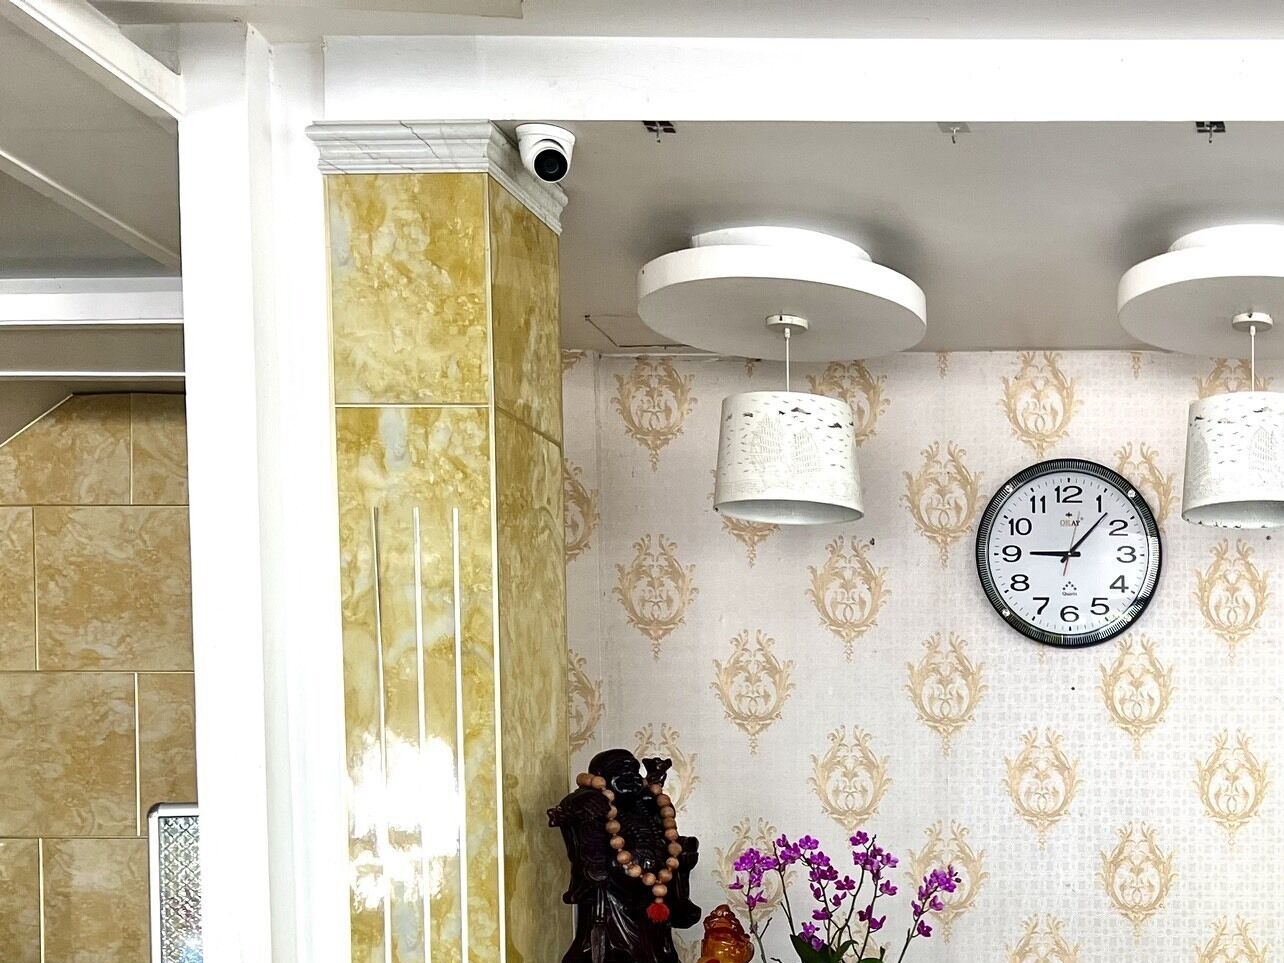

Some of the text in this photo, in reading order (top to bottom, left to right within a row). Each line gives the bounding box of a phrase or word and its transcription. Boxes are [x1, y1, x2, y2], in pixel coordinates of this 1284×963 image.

[1055, 485, 1083, 503] 12
[1030, 495, 1046, 514] 11
[1096, 495, 1102, 513] 1
[1008, 518, 1032, 536] 10
[1108, 519, 1129, 537] 2
[1002, 545, 1022, 563] 9
[1117, 545, 1137, 564] 3
[1010, 574, 1030, 592] 8
[1109, 575, 1129, 593] 4
[1032, 597, 1050, 615] 7
[1060, 605, 1080, 622] 6
[1090, 597, 1110, 616] 5
